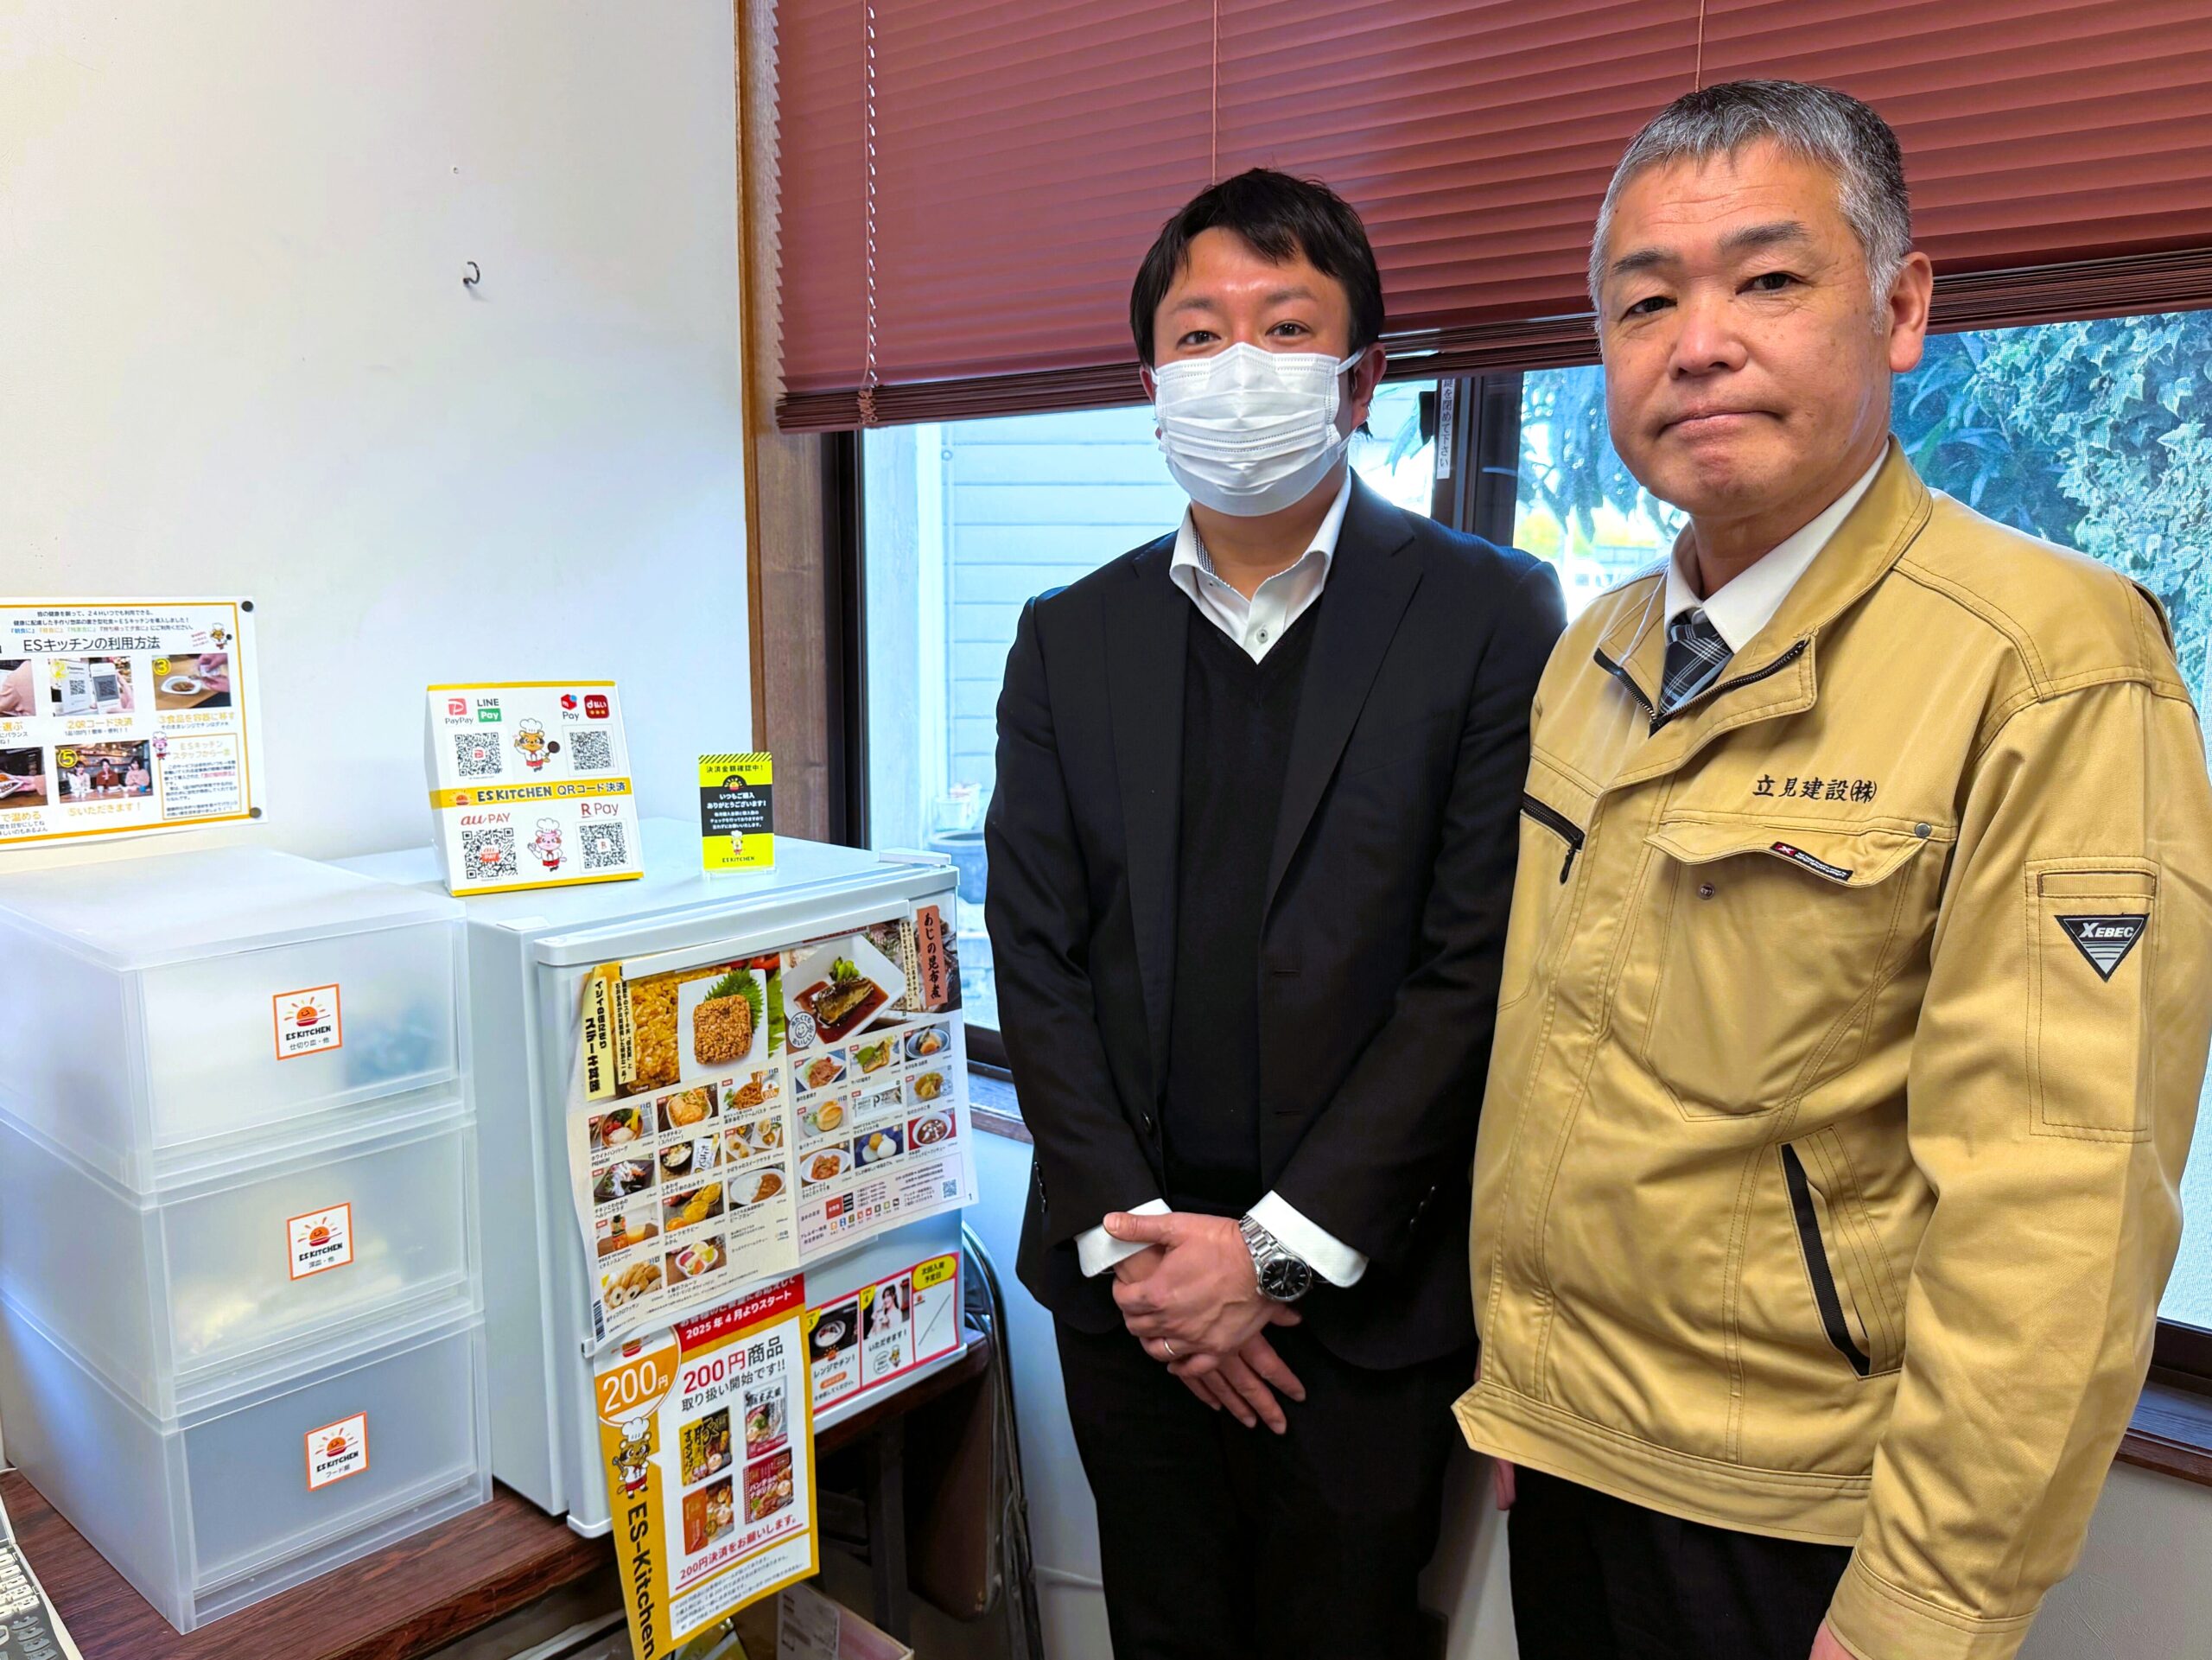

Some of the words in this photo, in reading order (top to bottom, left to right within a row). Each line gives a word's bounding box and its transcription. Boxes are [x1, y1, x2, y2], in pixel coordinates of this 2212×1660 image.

[22, 636, 162, 652] ESキッチンの利用方法
[477, 697, 499, 708] LINE
[445, 716, 474, 726] PayPay
[480, 709, 500, 722] Pay
[563, 710, 580, 722] Pay
[0, 722, 23, 731] 選ぶ
[707, 765, 764, 773] 決済金額確認中！
[478, 790, 495, 803] ES
[496, 785, 552, 800] KITCHEN
[557, 782, 626, 796] QRコード決済
[488, 812, 511, 824] PAY
[582, 804, 592, 818] R
[594, 802, 620, 817] Pay
[2079, 922, 2134, 938] XEBEC
[286, 1033, 296, 1041] ES
[297, 1025, 331, 1038] KITCHEN
[308, 1243, 343, 1259] KITCHEN
[683, 1335, 785, 1395] 200円商品
[603, 1360, 669, 1414] 200円
[326, 1451, 359, 1470] KITCHEN
[626, 1502, 658, 1660] ES-Kitchen
